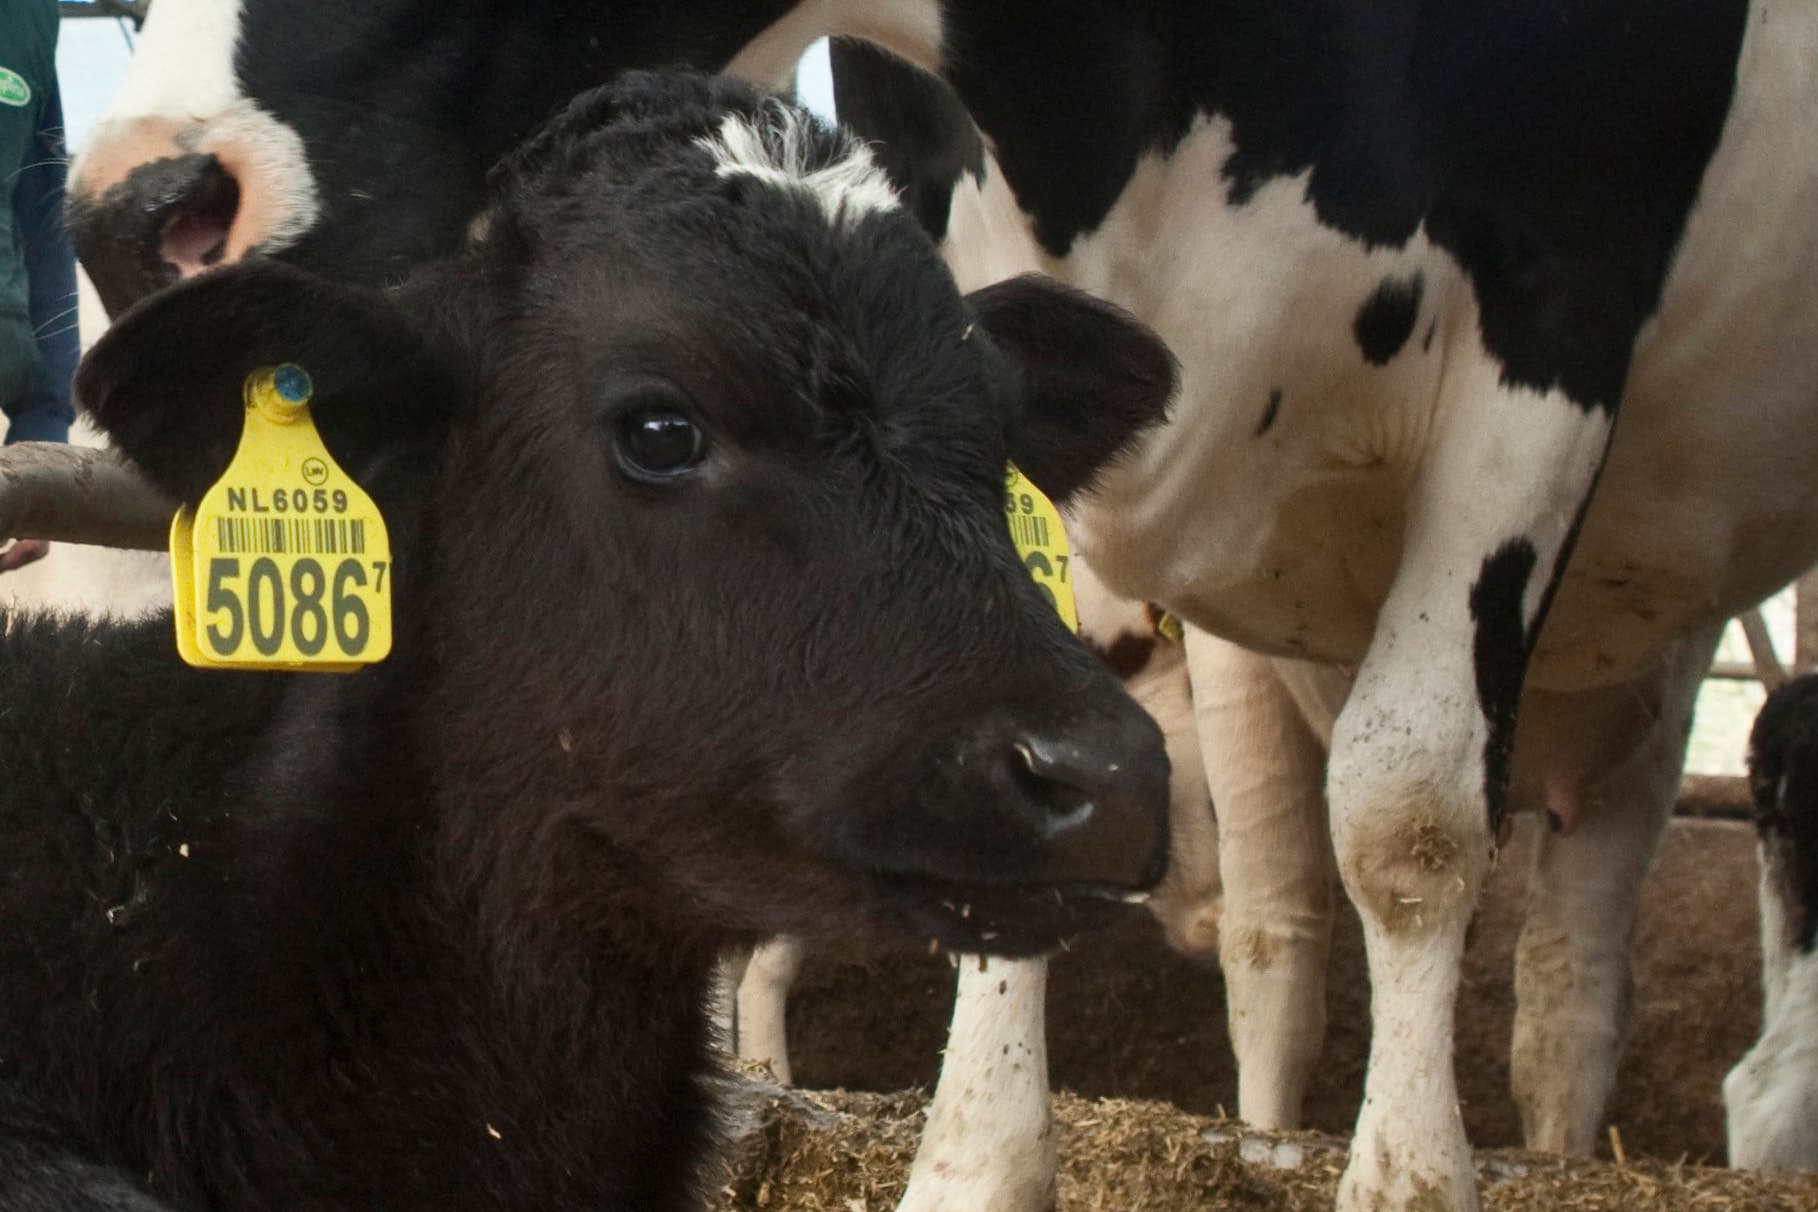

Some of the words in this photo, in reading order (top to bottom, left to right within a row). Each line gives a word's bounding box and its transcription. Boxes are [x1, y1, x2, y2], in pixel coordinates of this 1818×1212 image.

[227, 487, 349, 514] NL6059
[1055, 555, 1070, 583] 7
[205, 556, 370, 658] 5086
[372, 561, 387, 593] 7
